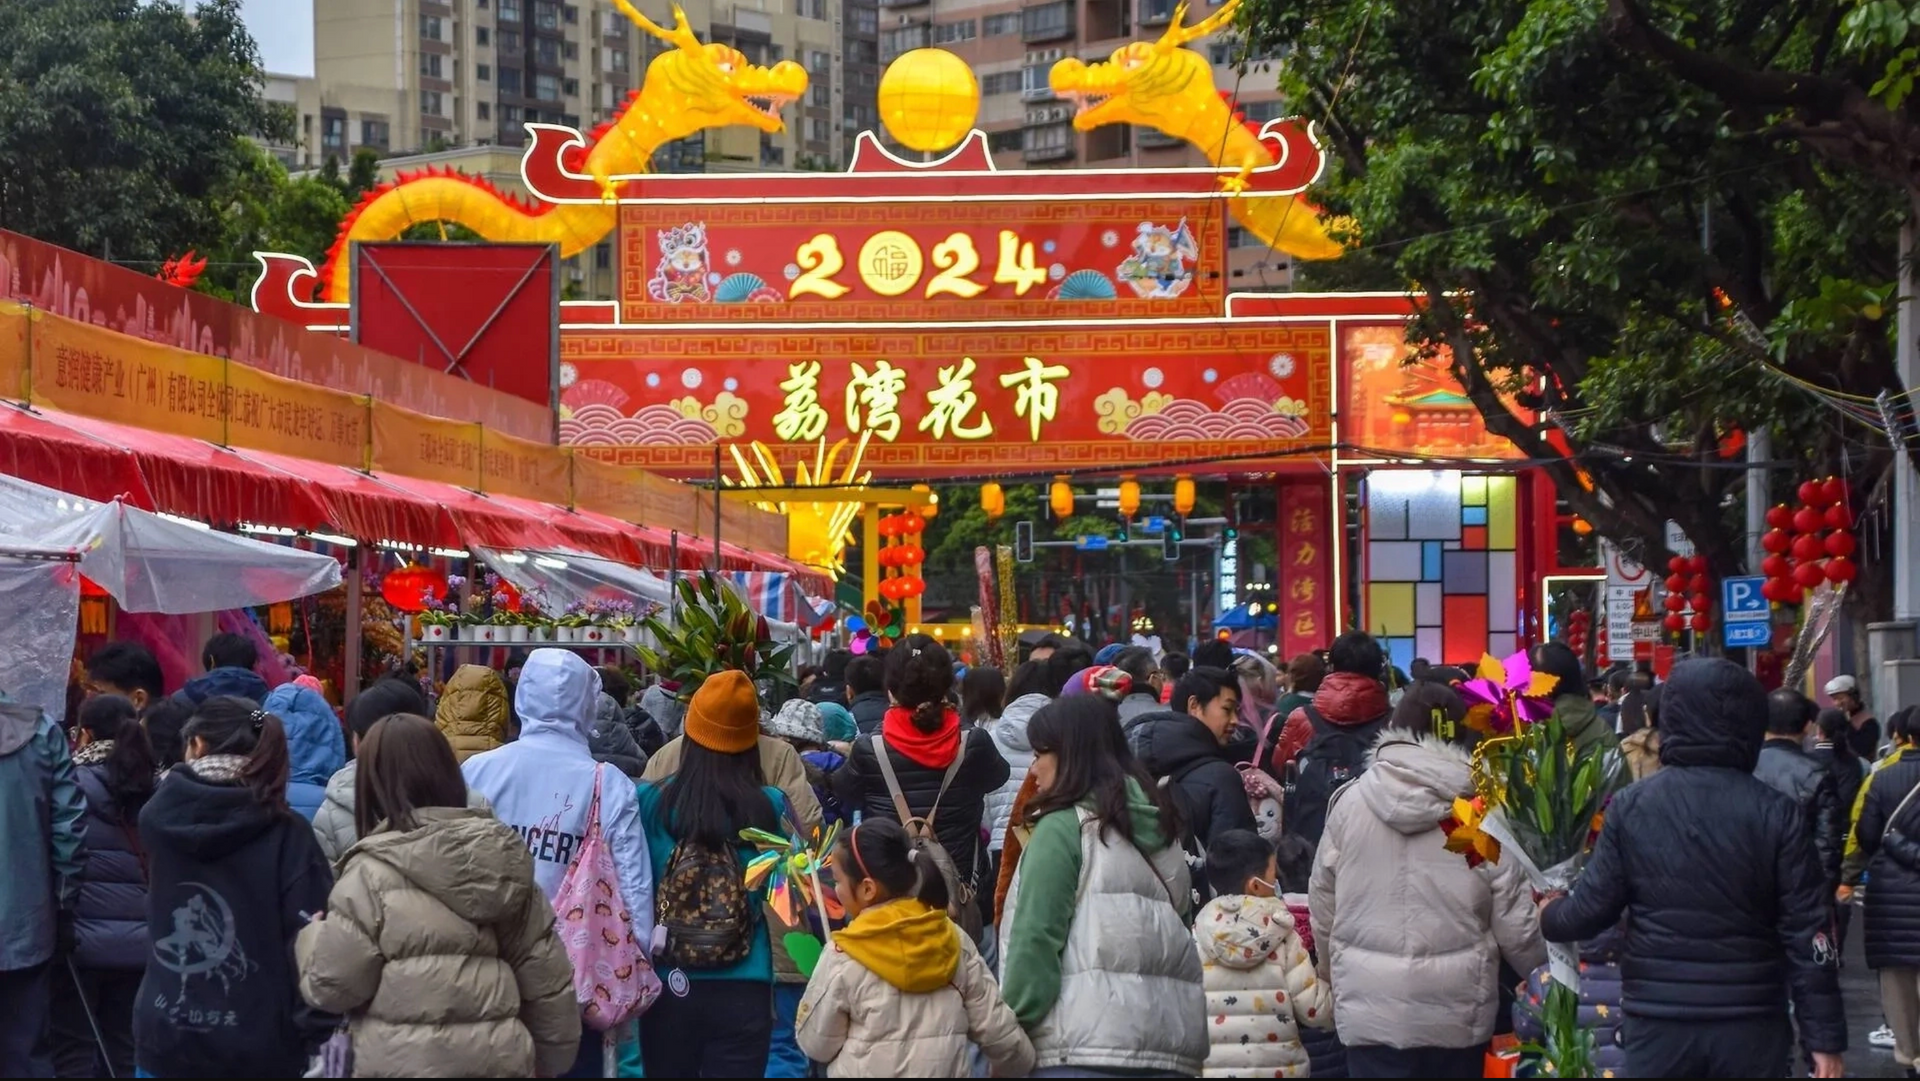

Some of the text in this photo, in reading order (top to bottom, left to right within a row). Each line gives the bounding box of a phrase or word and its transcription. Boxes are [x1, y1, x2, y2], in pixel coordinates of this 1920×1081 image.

[872, 244, 908, 281] 福
[772, 357, 1070, 443] 荔湾花市
[1290, 507, 1317, 637] 活力湾区
[1732, 582, 1751, 610] P
